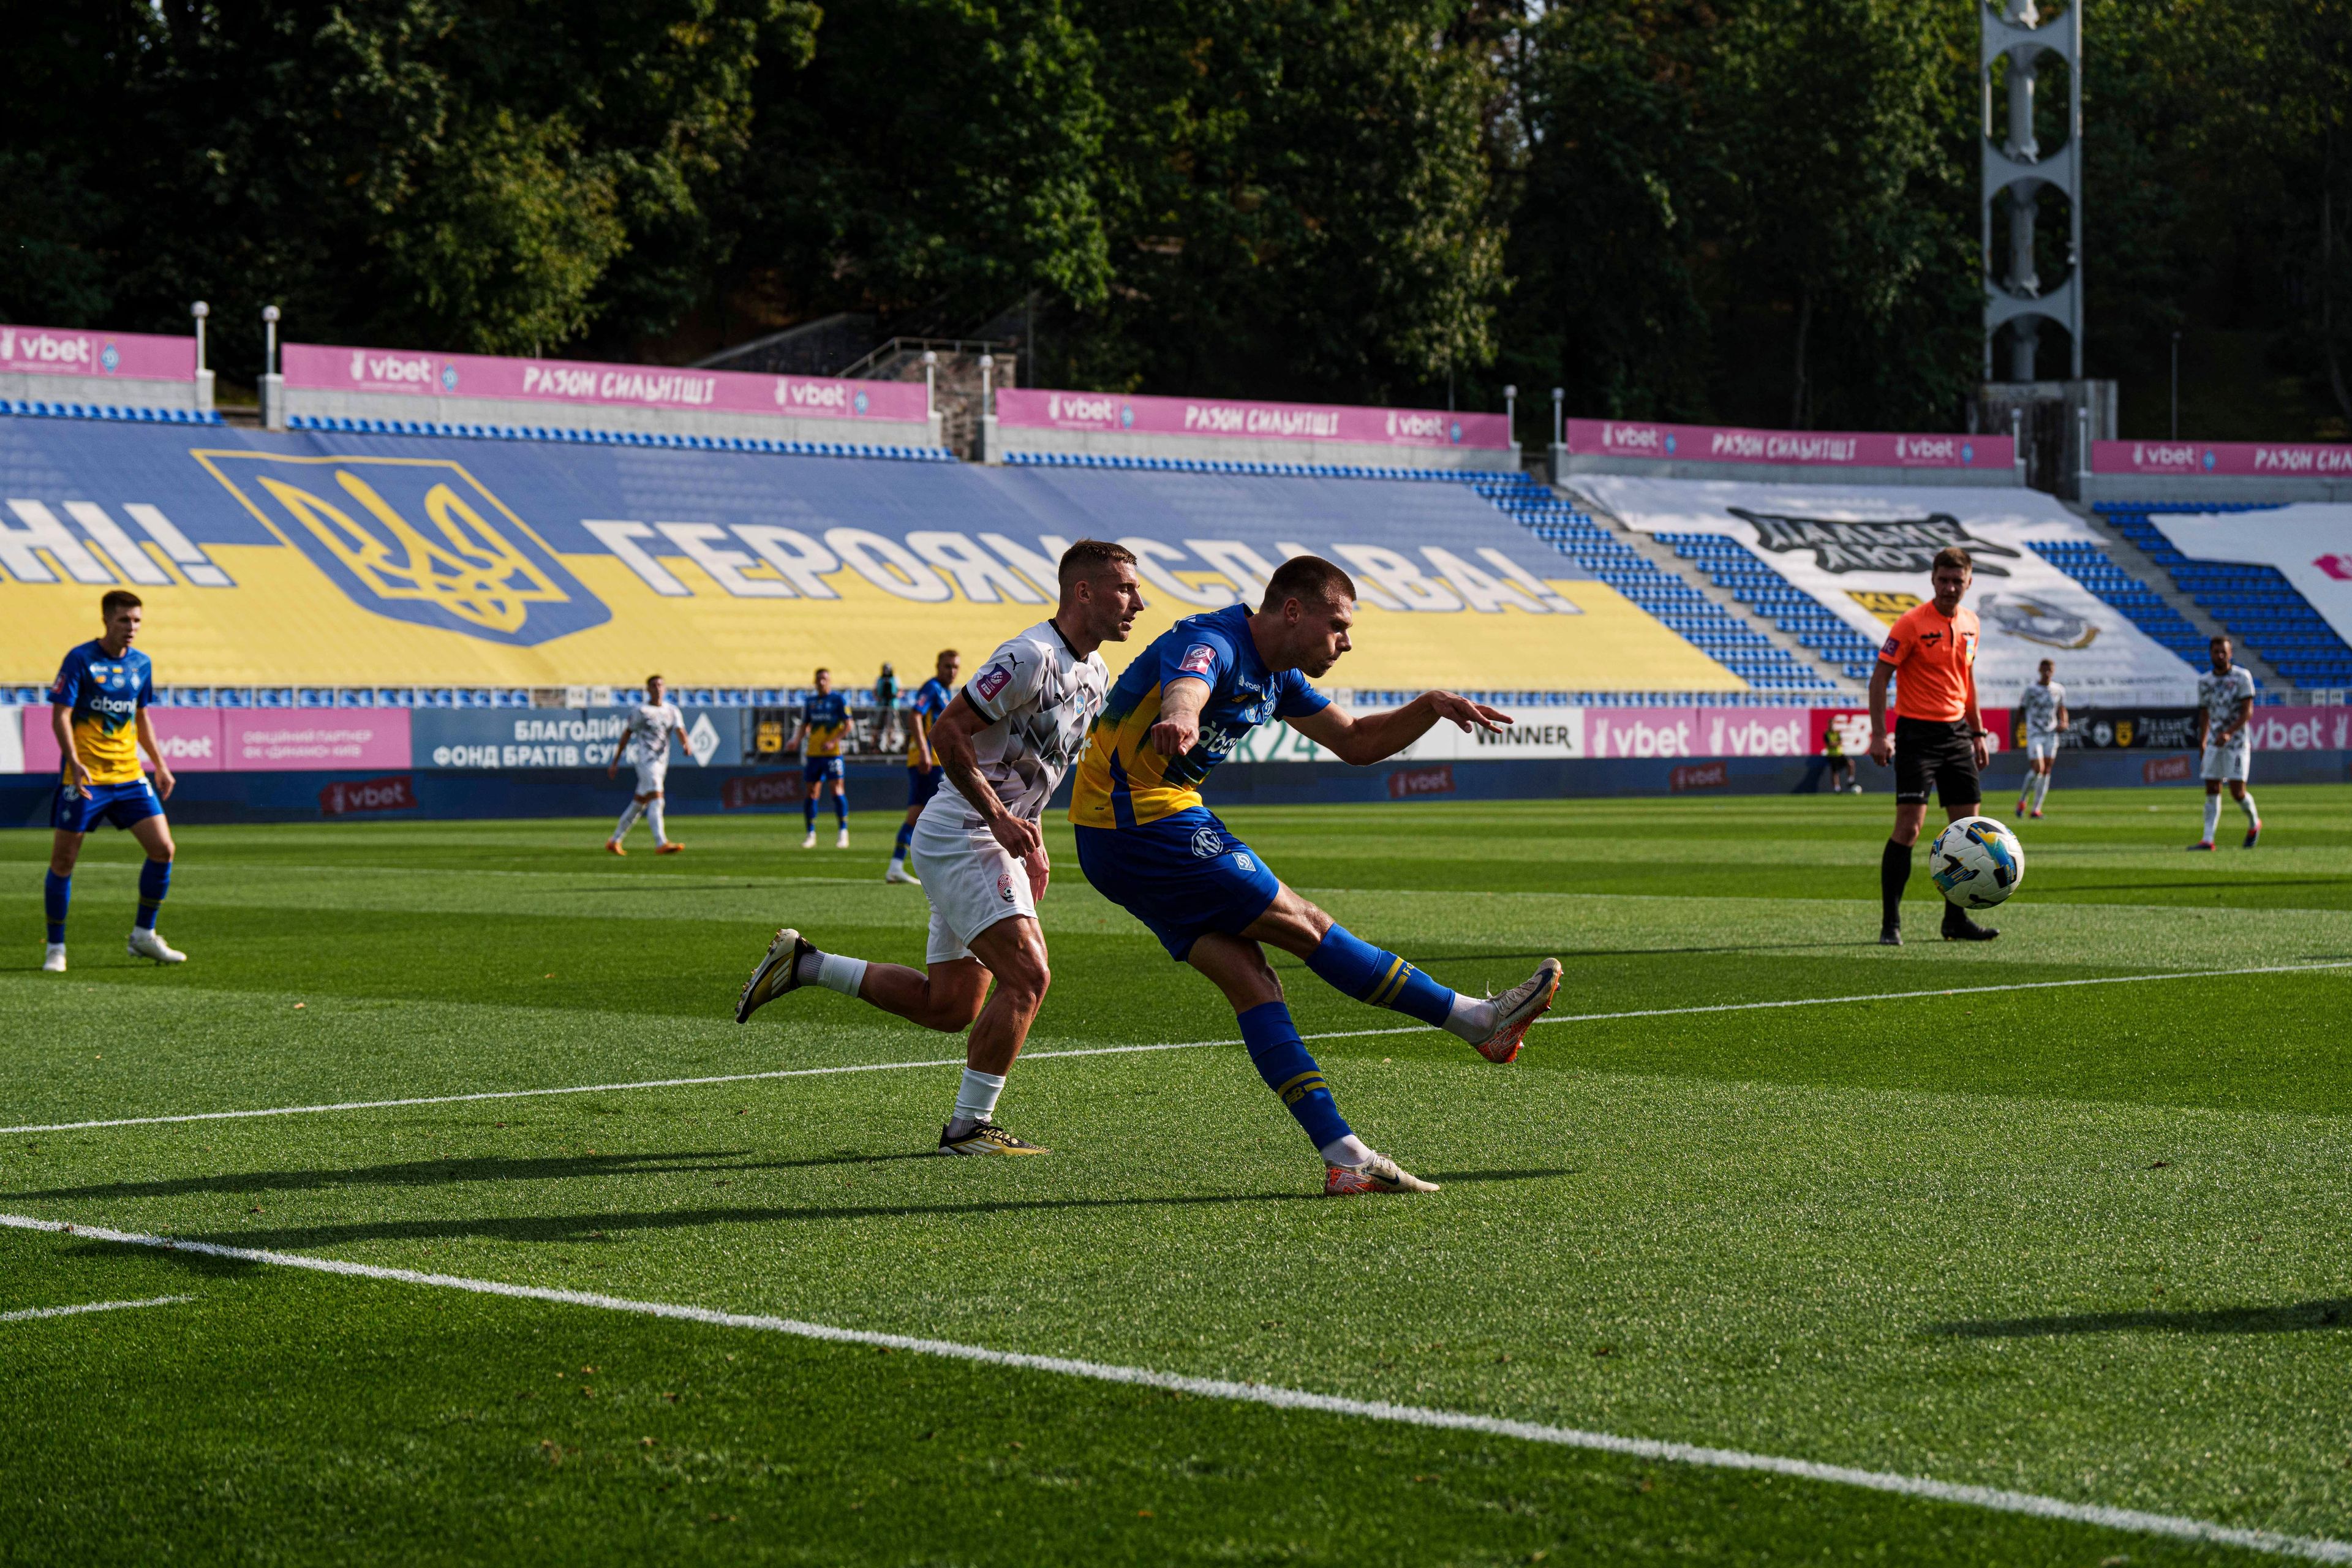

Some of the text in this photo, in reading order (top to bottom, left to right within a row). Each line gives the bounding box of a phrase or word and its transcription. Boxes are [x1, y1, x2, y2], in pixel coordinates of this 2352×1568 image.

[20, 334, 90, 363] vbet
[369, 355, 432, 383] vbet
[791, 381, 846, 408] vbet
[1063, 396, 1113, 421] vbet
[2147, 445, 2195, 466] vbet
[1244, 681, 1261, 693] vbet
[1474, 721, 1572, 750] WINNER
[1612, 720, 1691, 758] vbet
[1728, 718, 1802, 756] vbet
[2248, 717, 2323, 750] vbet
[433, 745, 501, 769] ФОНД
[503, 745, 579, 766] БРАТІВ
[348, 782, 405, 808] vbet
